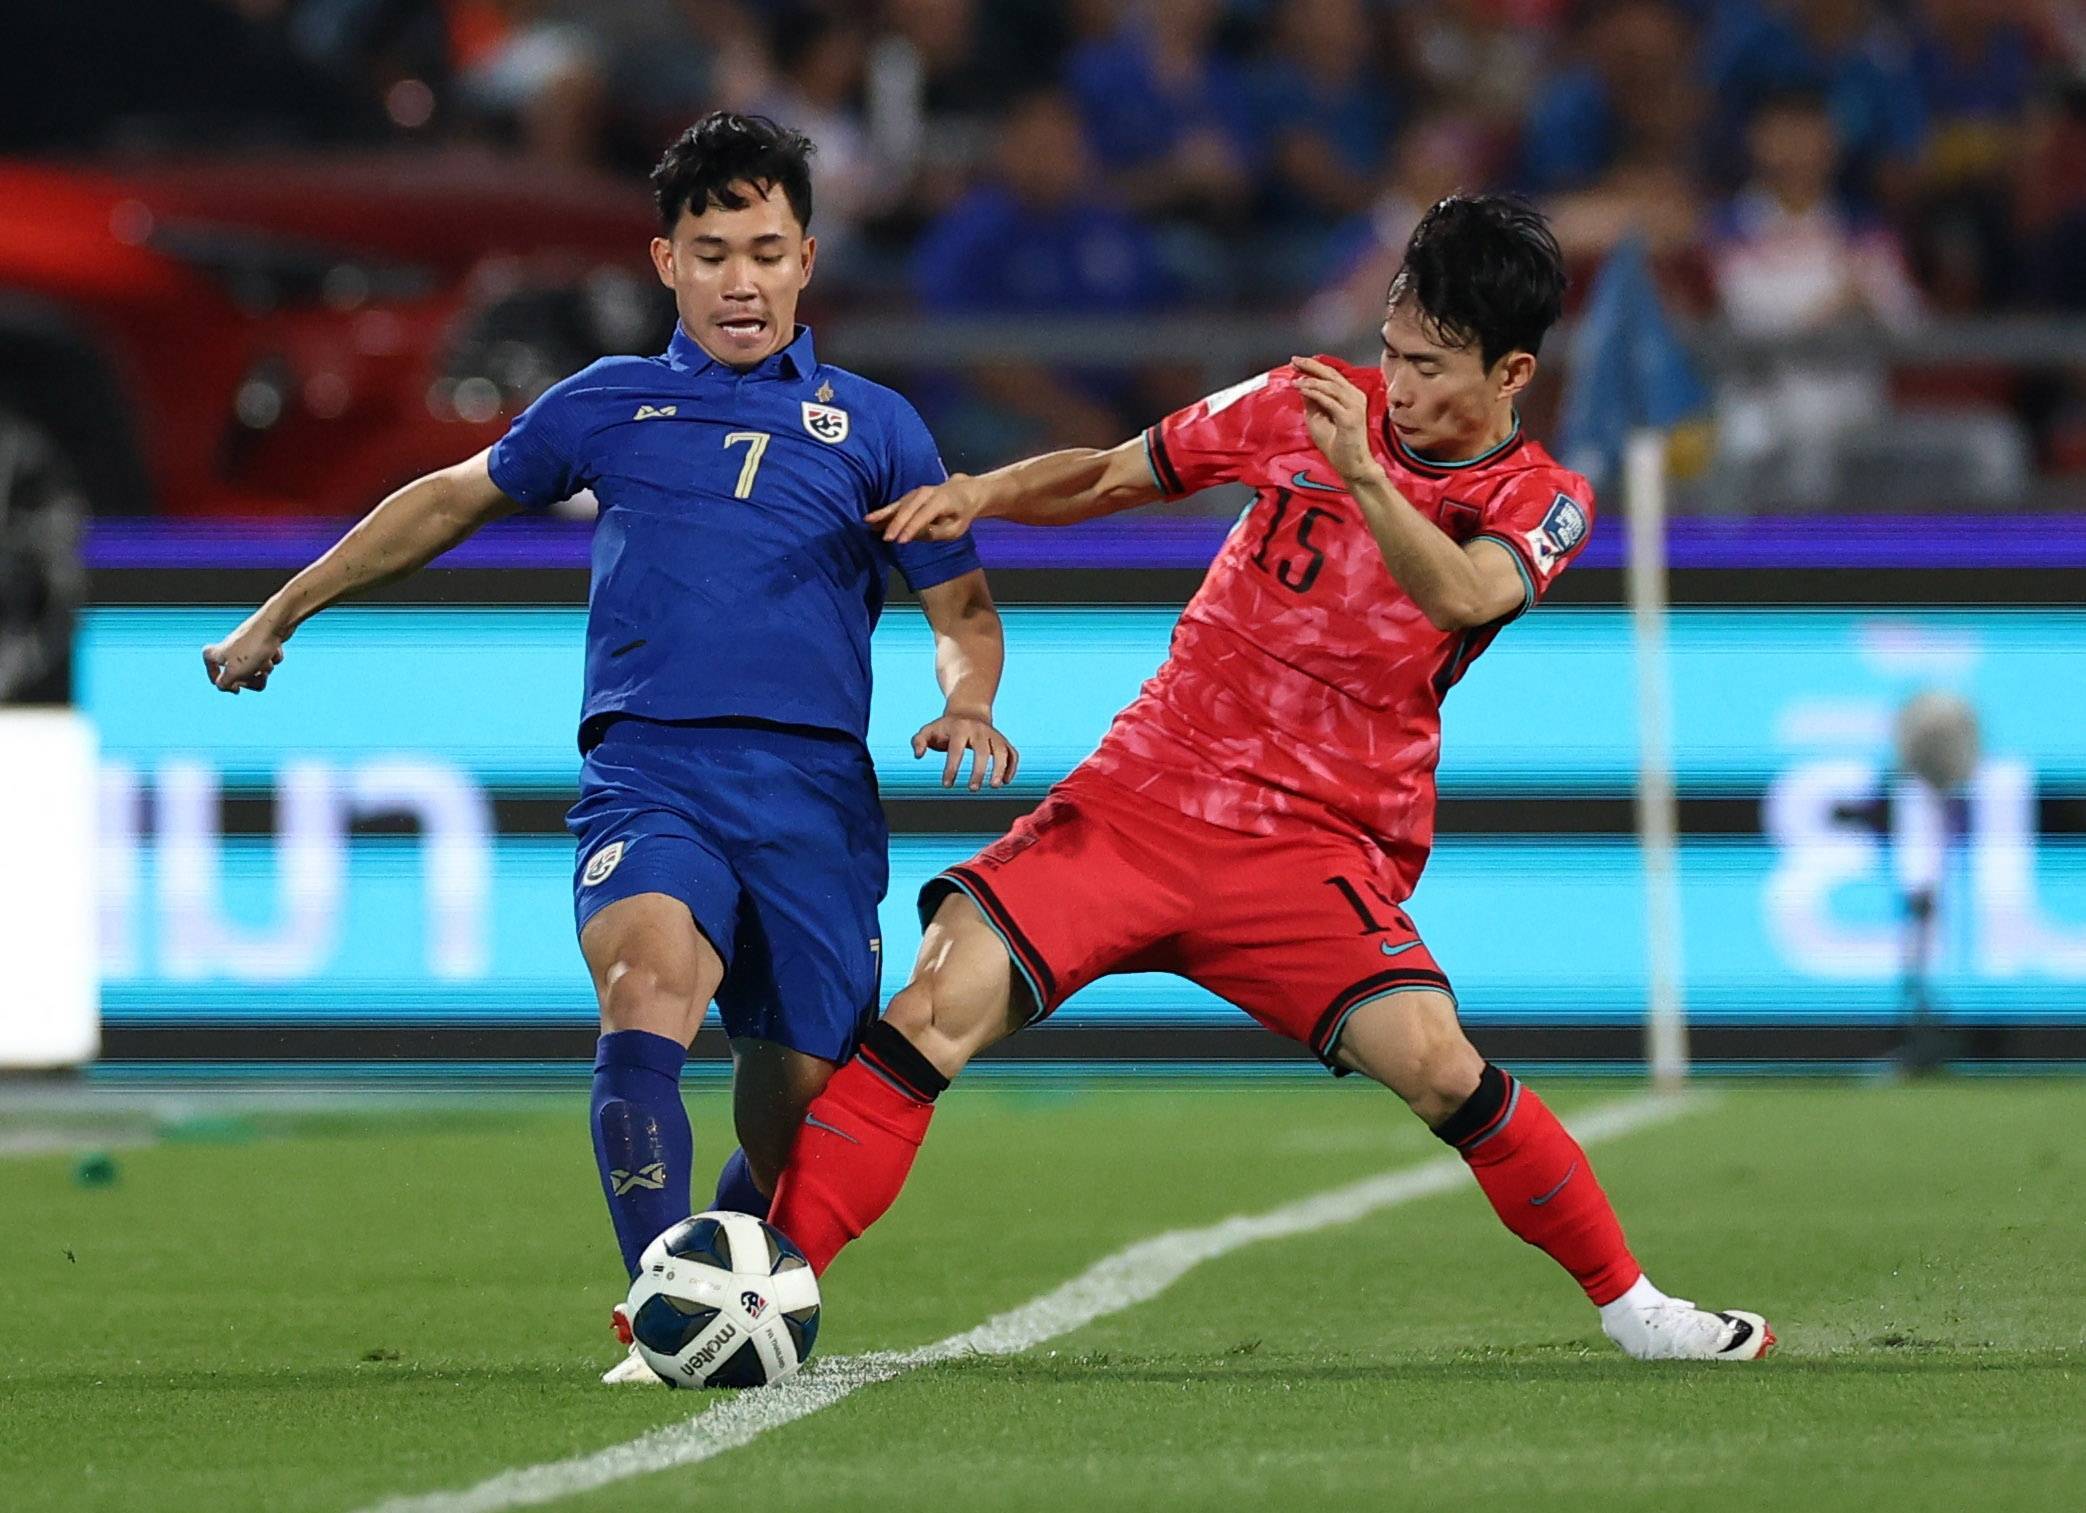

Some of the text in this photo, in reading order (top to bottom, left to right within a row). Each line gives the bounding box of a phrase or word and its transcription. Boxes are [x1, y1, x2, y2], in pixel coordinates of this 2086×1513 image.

[724, 432, 770, 499] 7
[1250, 486, 1345, 593] 15
[680, 1322, 736, 1376] molten
